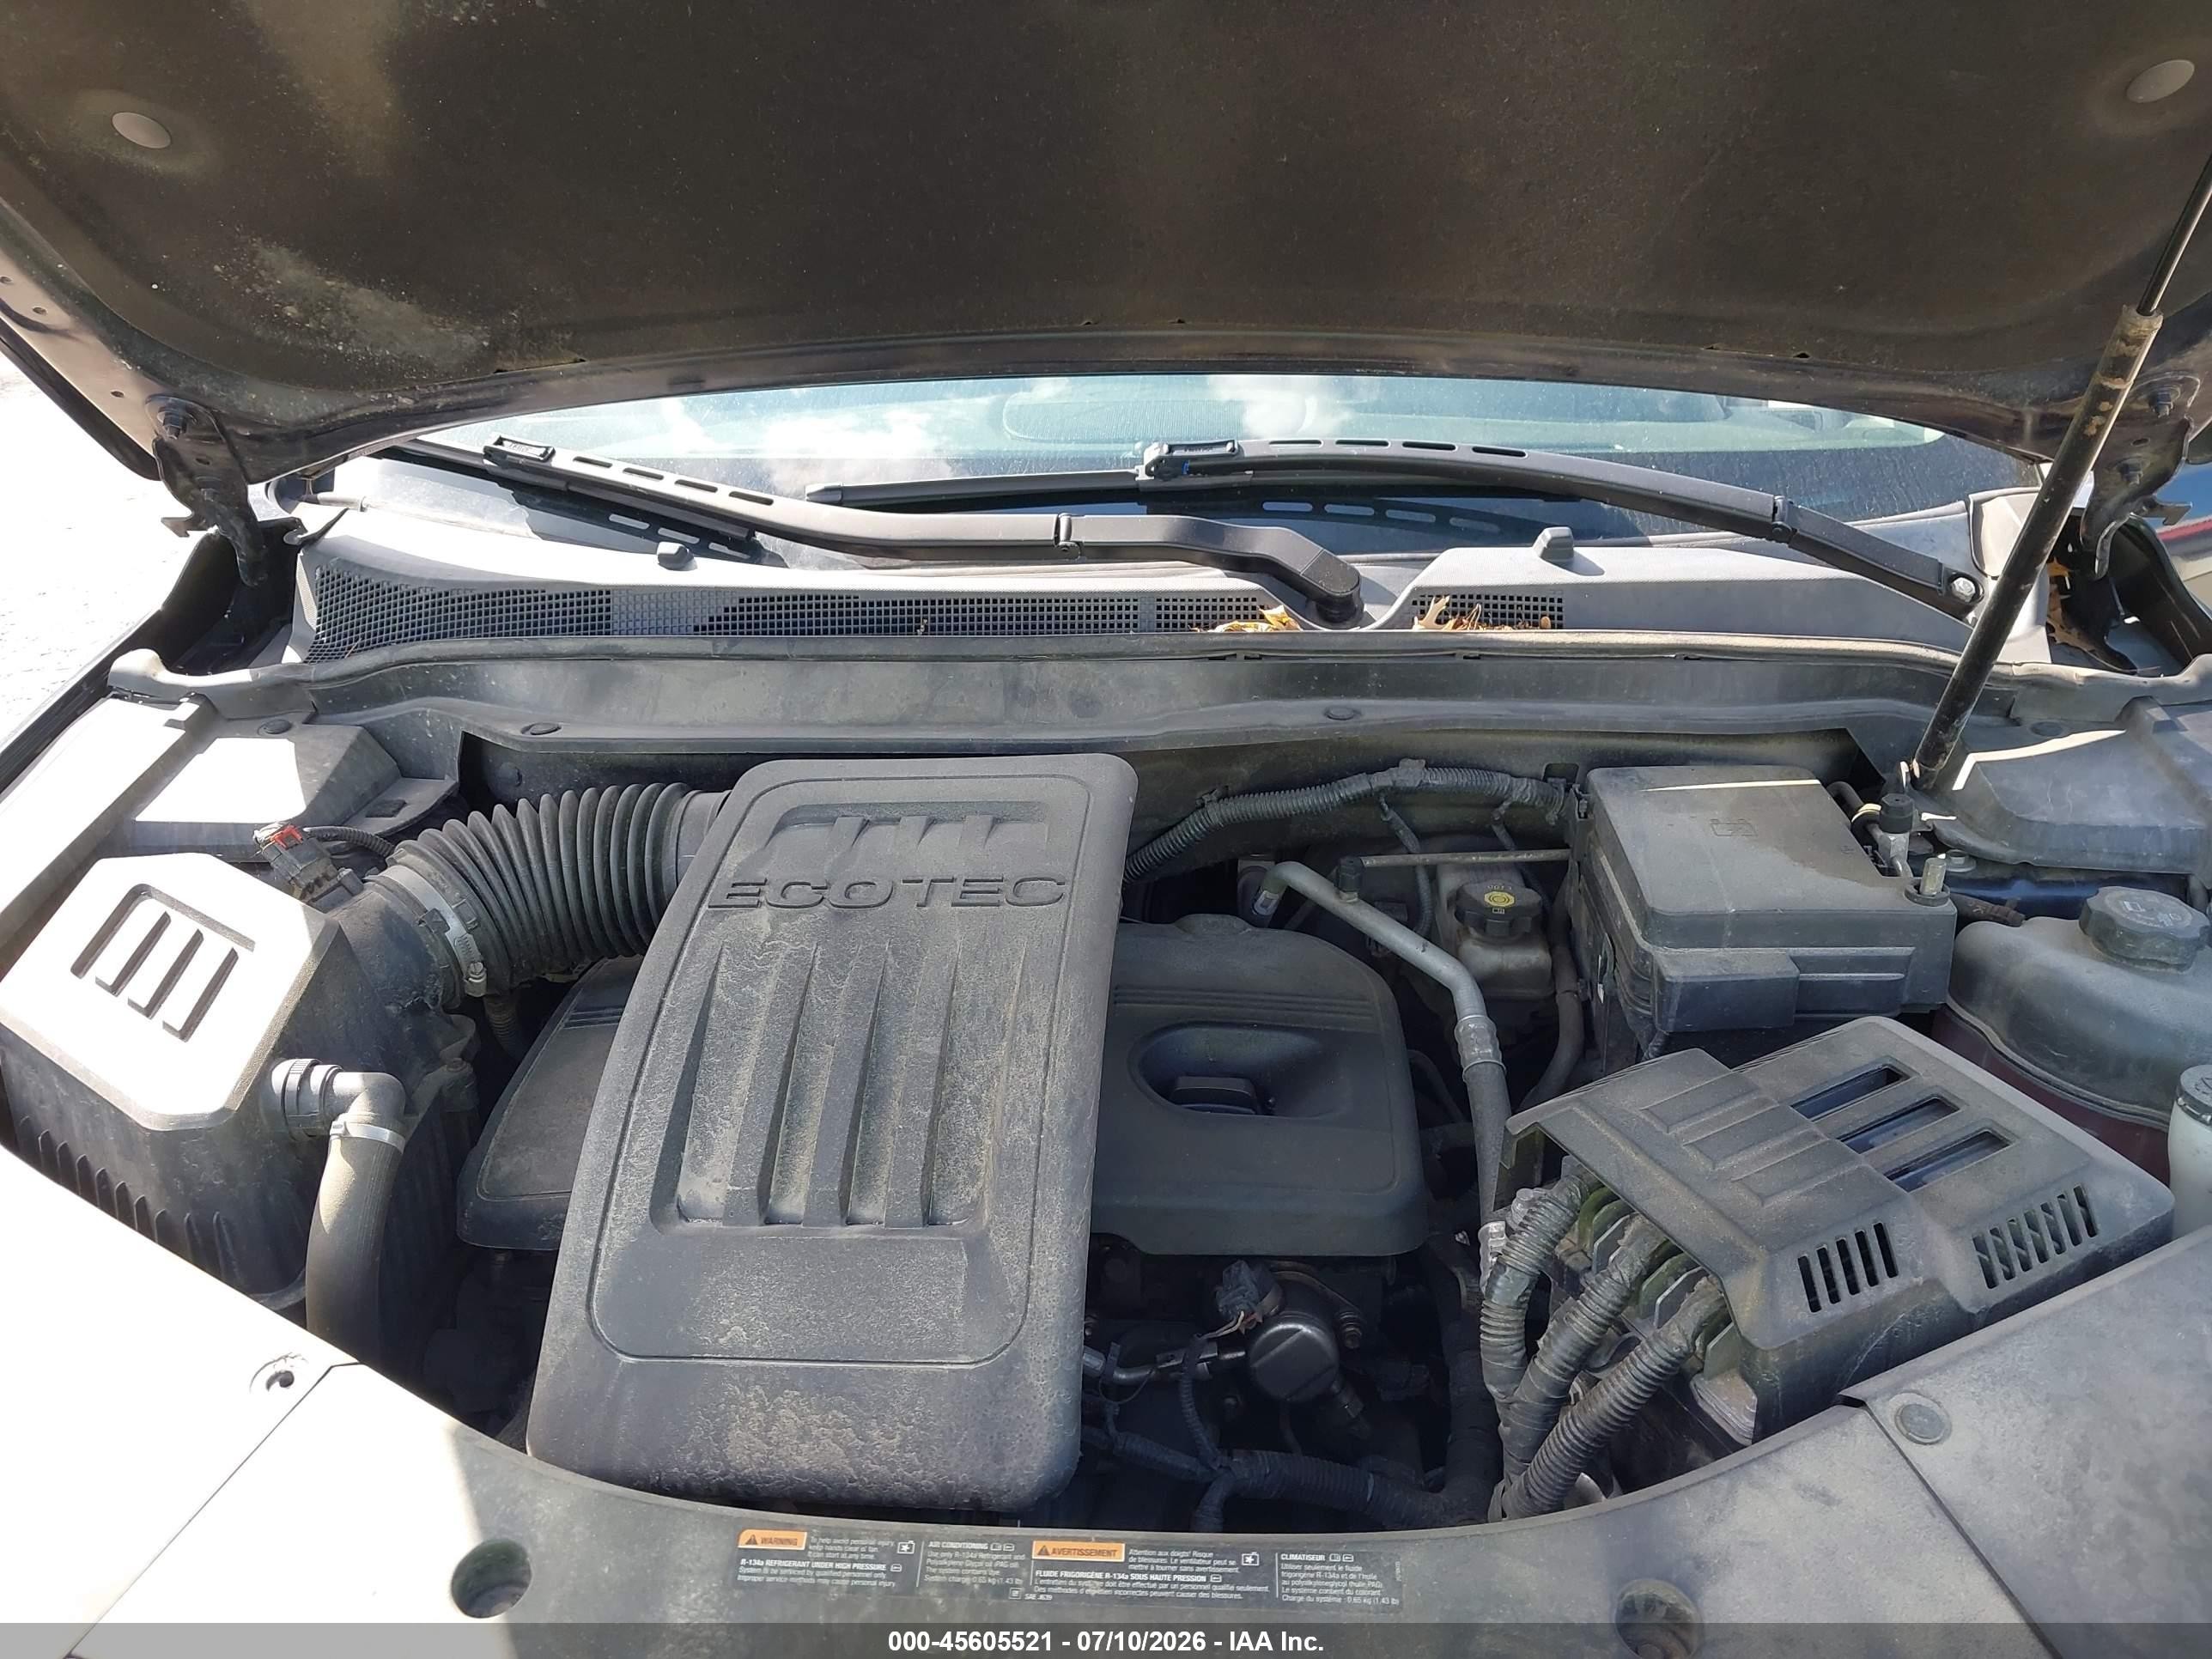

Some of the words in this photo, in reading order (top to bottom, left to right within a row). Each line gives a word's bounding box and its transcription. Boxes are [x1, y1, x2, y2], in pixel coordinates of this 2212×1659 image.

[707, 874, 1066, 909] ECOTEC
[761, 1537, 798, 1547] WARNING
[941, 1541, 989, 1550] CONDITIONING
[1051, 1547, 1118, 1558] AVERTISSEMENT
[740, 1558, 764, 1566] R-134a
[852, 1563, 887, 1571] PRESSURE
[1172, 1574, 1207, 1583] PRESSION
